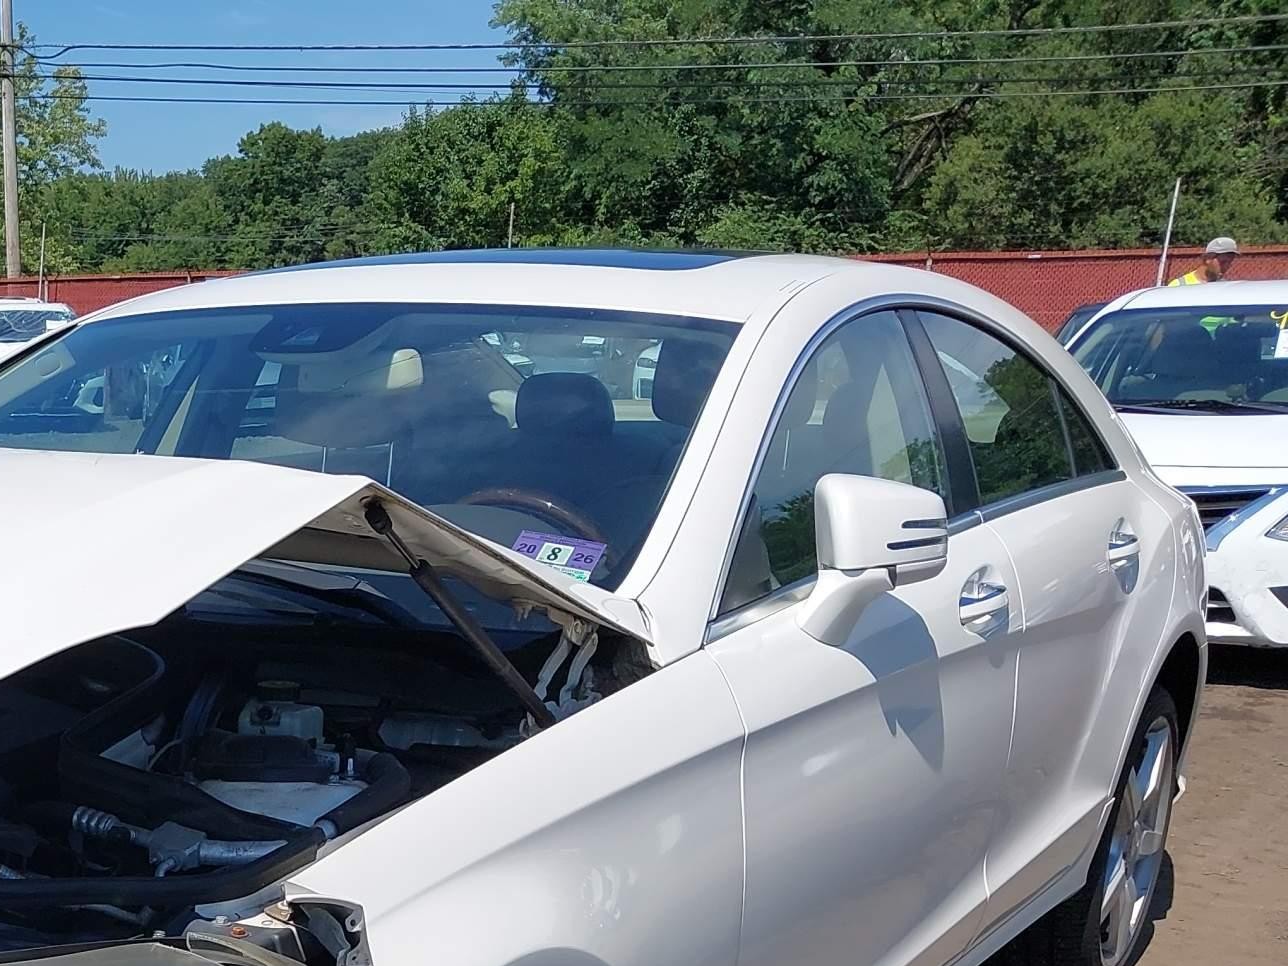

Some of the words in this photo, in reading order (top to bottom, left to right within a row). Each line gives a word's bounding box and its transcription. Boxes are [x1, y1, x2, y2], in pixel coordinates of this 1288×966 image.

[516, 542, 537, 554] 20
[546, 546, 562, 561] 8
[573, 552, 594, 564] 26
